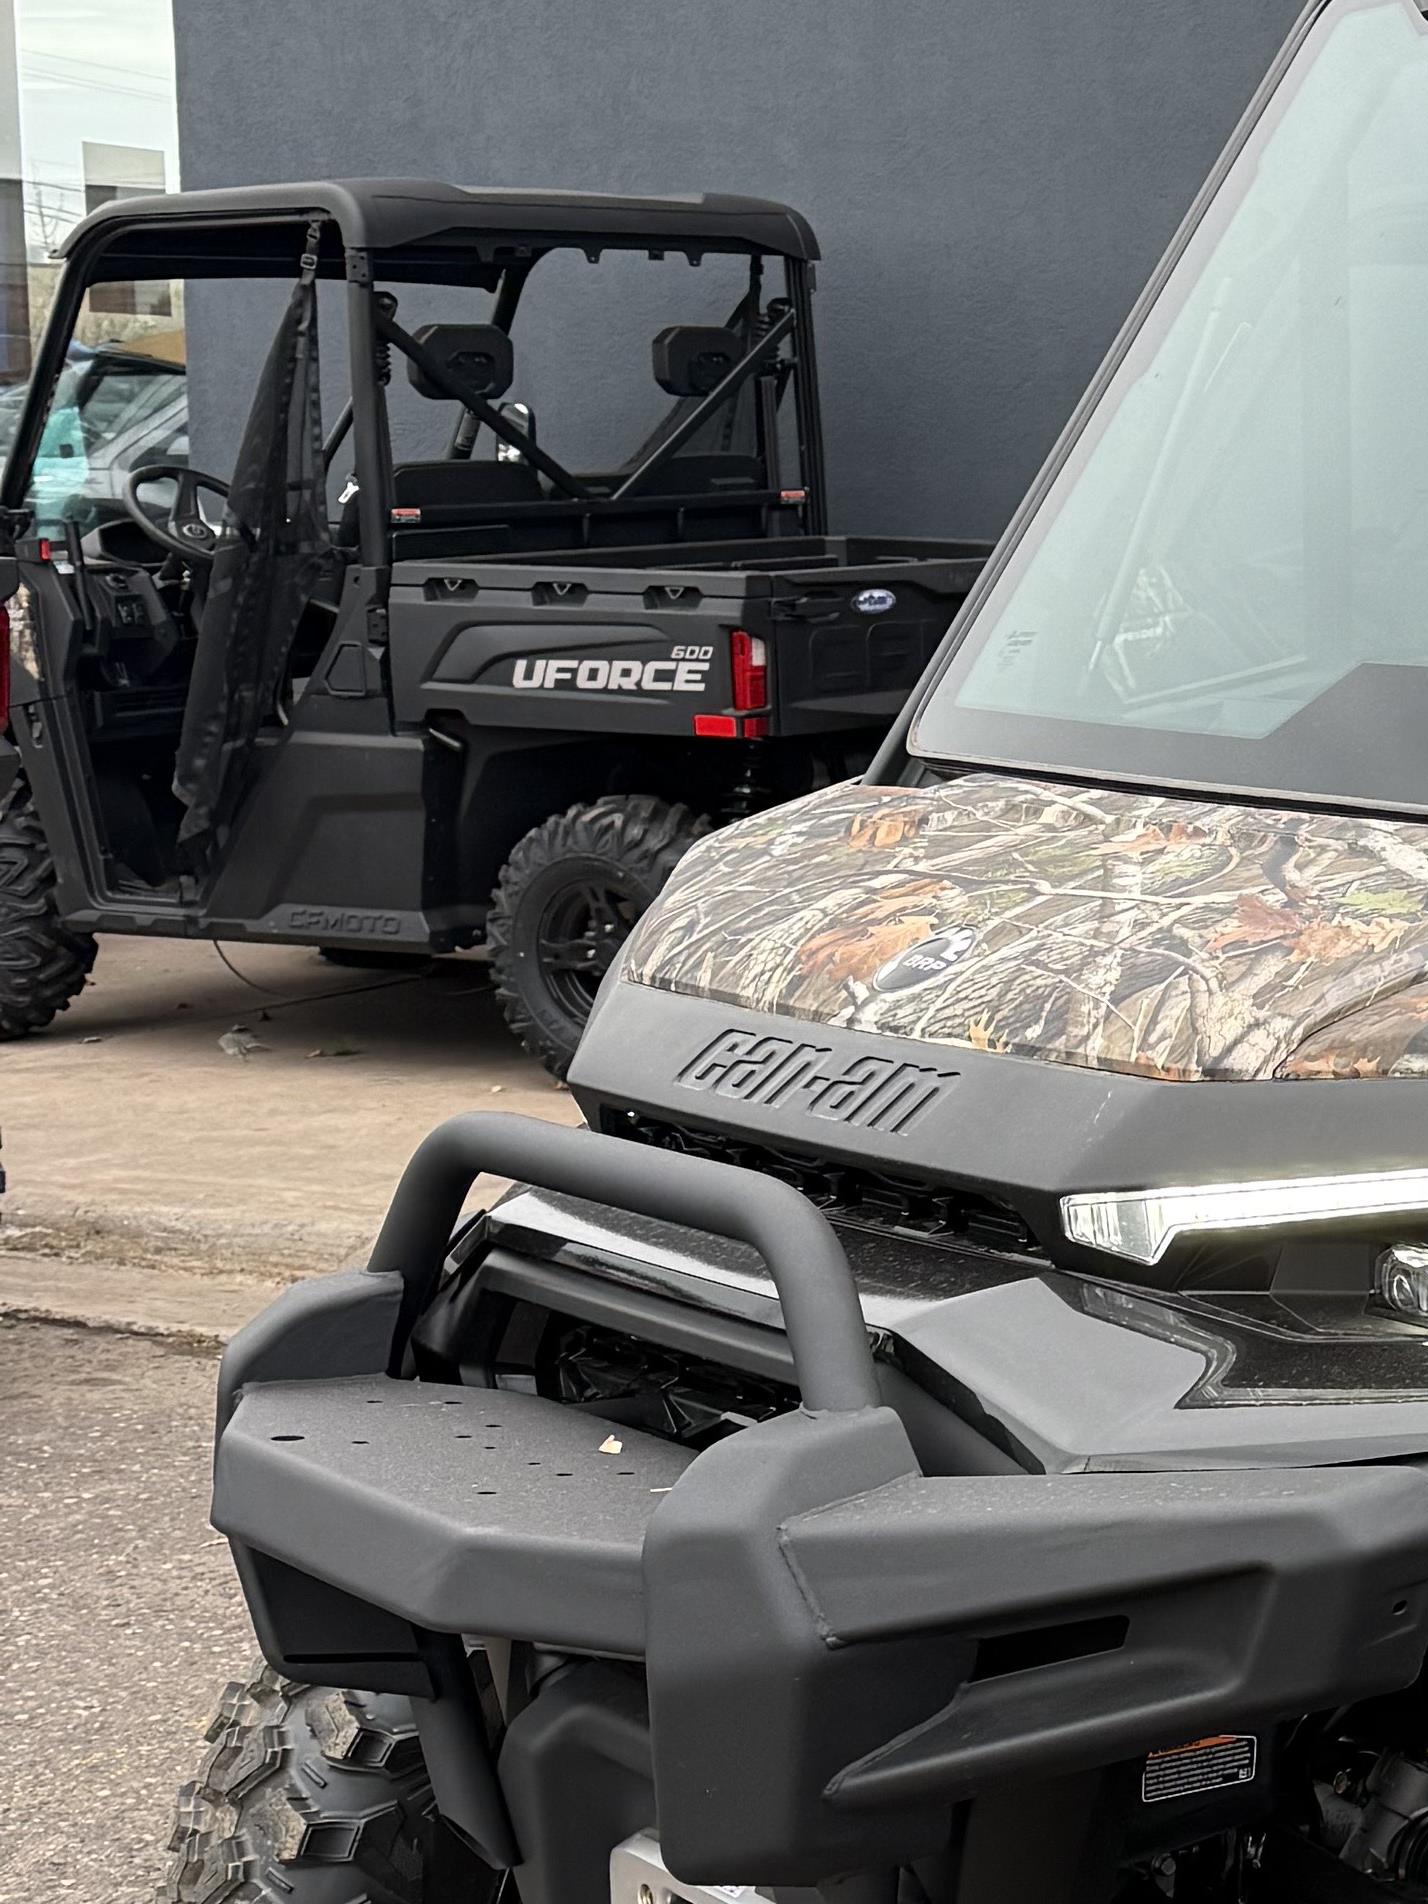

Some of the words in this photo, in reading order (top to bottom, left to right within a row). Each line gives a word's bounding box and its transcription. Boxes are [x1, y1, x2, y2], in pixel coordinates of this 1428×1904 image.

[670, 645, 715, 660] 600
[512, 659, 711, 692] UFORCE
[288, 909, 402, 936] CFMOTO
